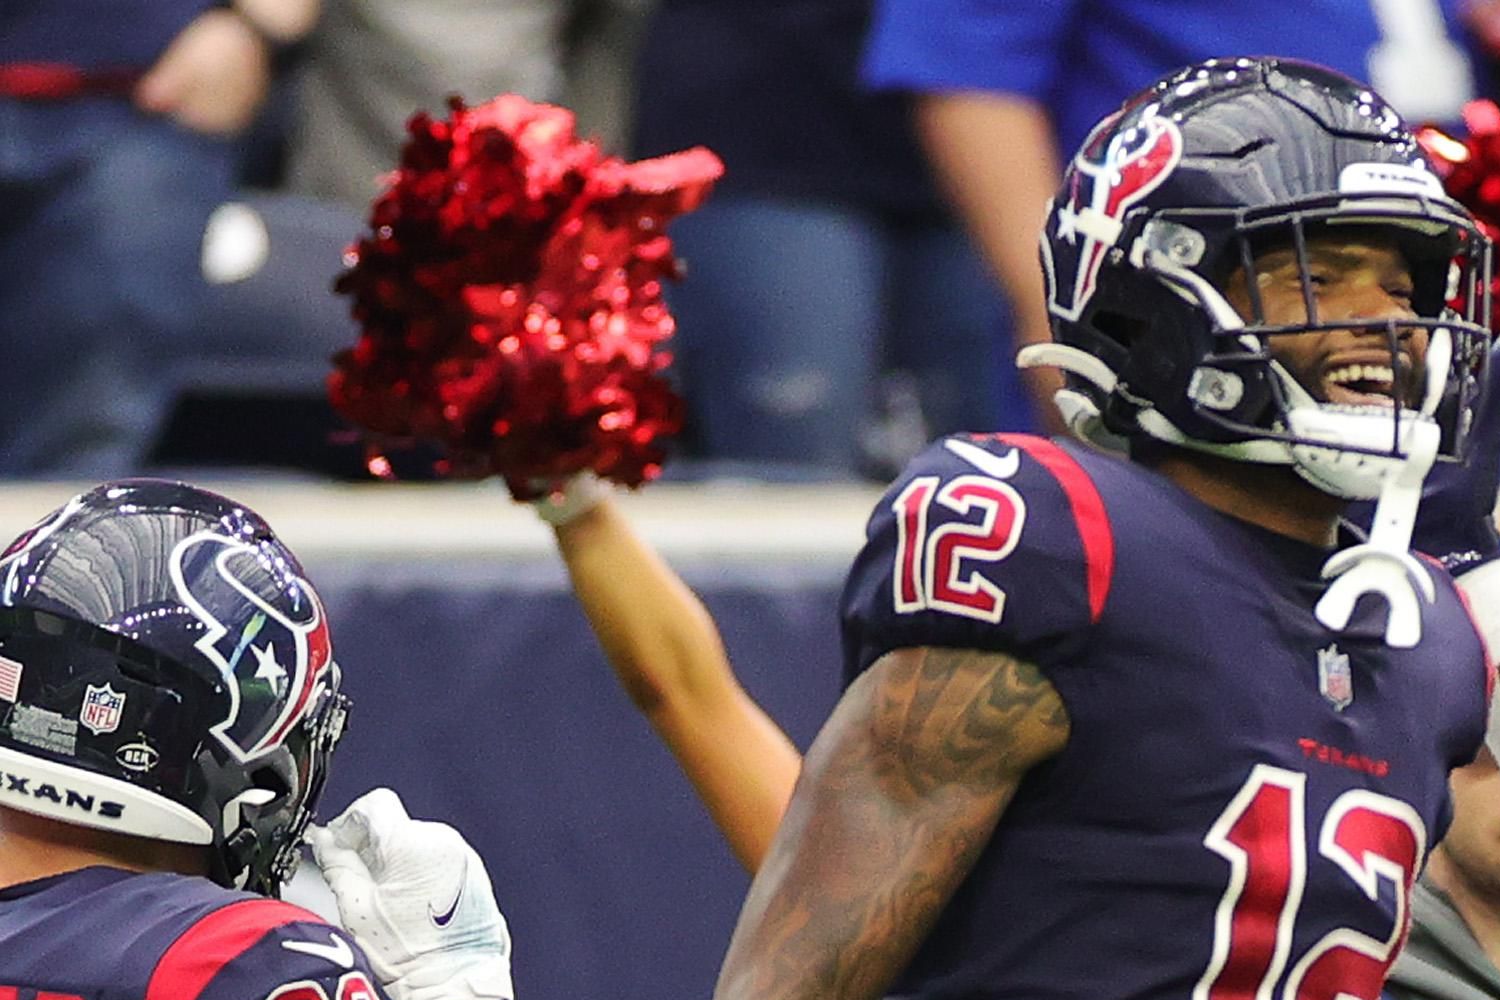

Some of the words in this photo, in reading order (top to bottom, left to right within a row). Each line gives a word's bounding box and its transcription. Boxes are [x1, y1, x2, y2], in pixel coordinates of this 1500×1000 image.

[892, 474, 1026, 624] 12
[86, 705, 116, 728] NFL
[0, 771, 126, 818] XANS
